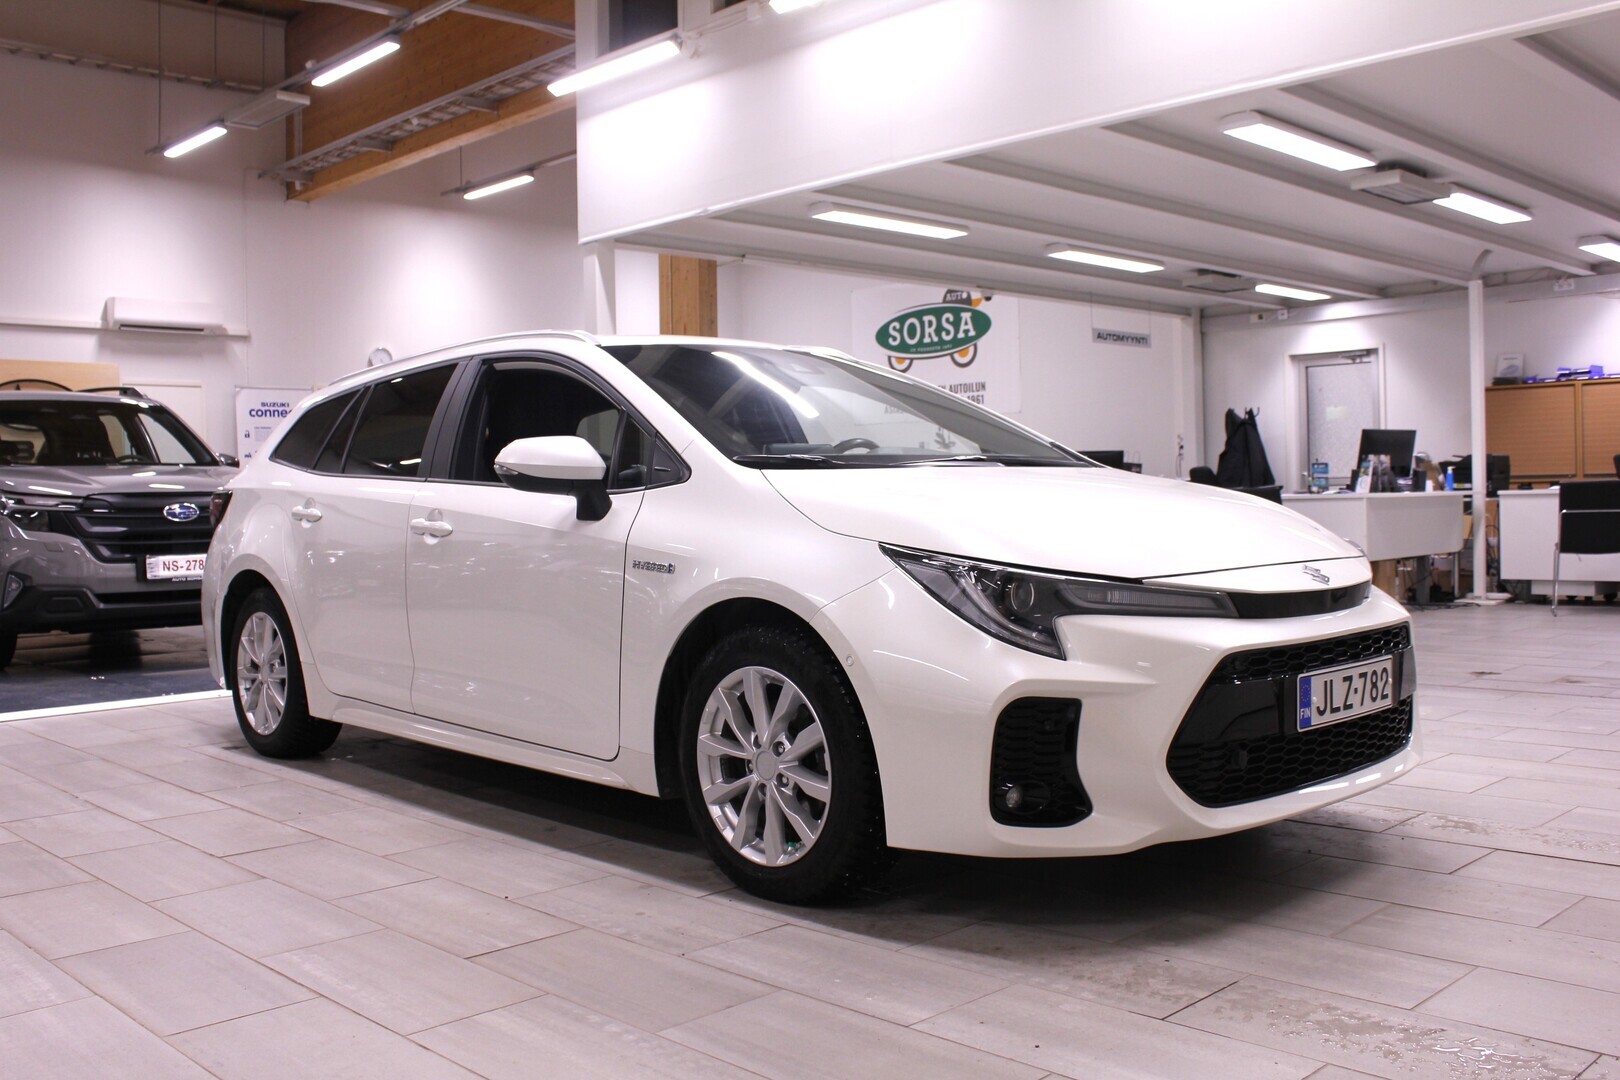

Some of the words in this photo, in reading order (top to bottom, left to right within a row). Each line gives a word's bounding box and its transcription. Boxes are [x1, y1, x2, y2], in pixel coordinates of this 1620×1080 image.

[945, 291, 968, 301] AUTO
[888, 312, 976, 346] SORSA
[1097, 331, 1148, 345] AUTOMYYNTI
[949, 382, 986, 394] AUTOILUN
[1316, 667, 1389, 716] JLZ-782
[1300, 707, 1311, 719] FIN
